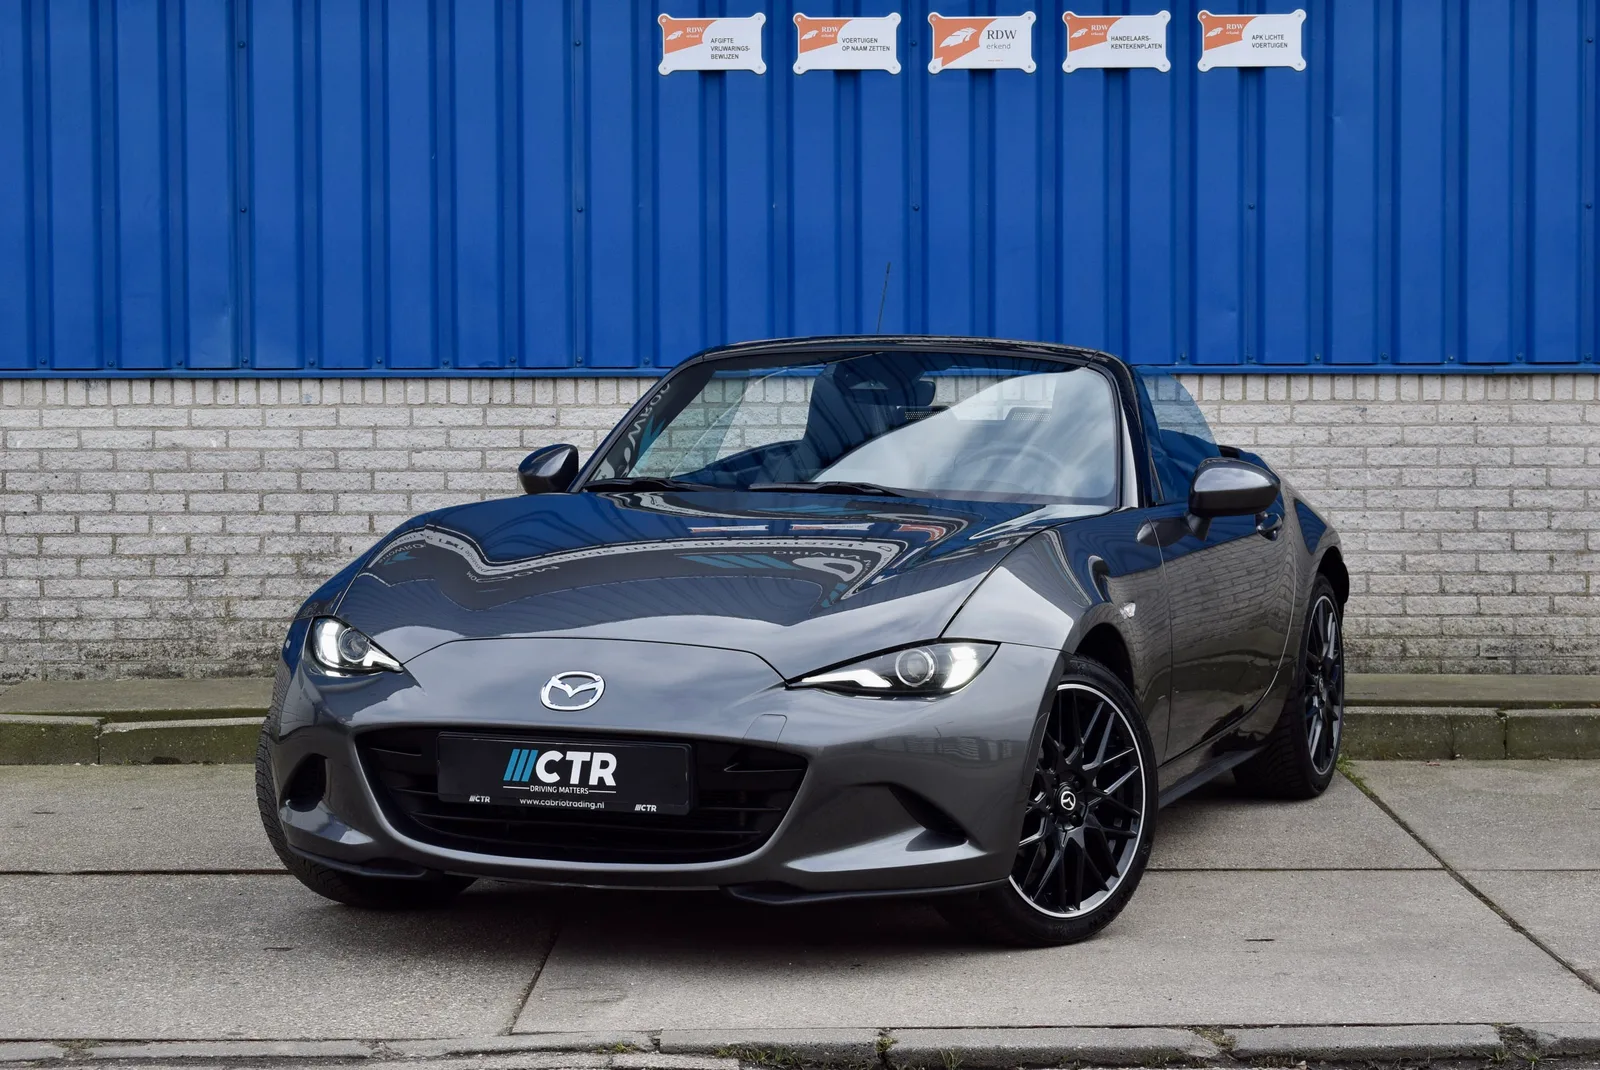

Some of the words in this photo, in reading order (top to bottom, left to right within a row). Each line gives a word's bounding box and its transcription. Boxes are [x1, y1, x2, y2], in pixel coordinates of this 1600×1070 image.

[686, 26, 704, 34] RDW
[987, 29, 1017, 40] RDW
[535, 750, 617, 786] CTR
[530, 785, 558, 793] DRIVING
[559, 786, 589, 795] MATTERS
[519, 798, 605, 810] www.cabriotrading.nl
